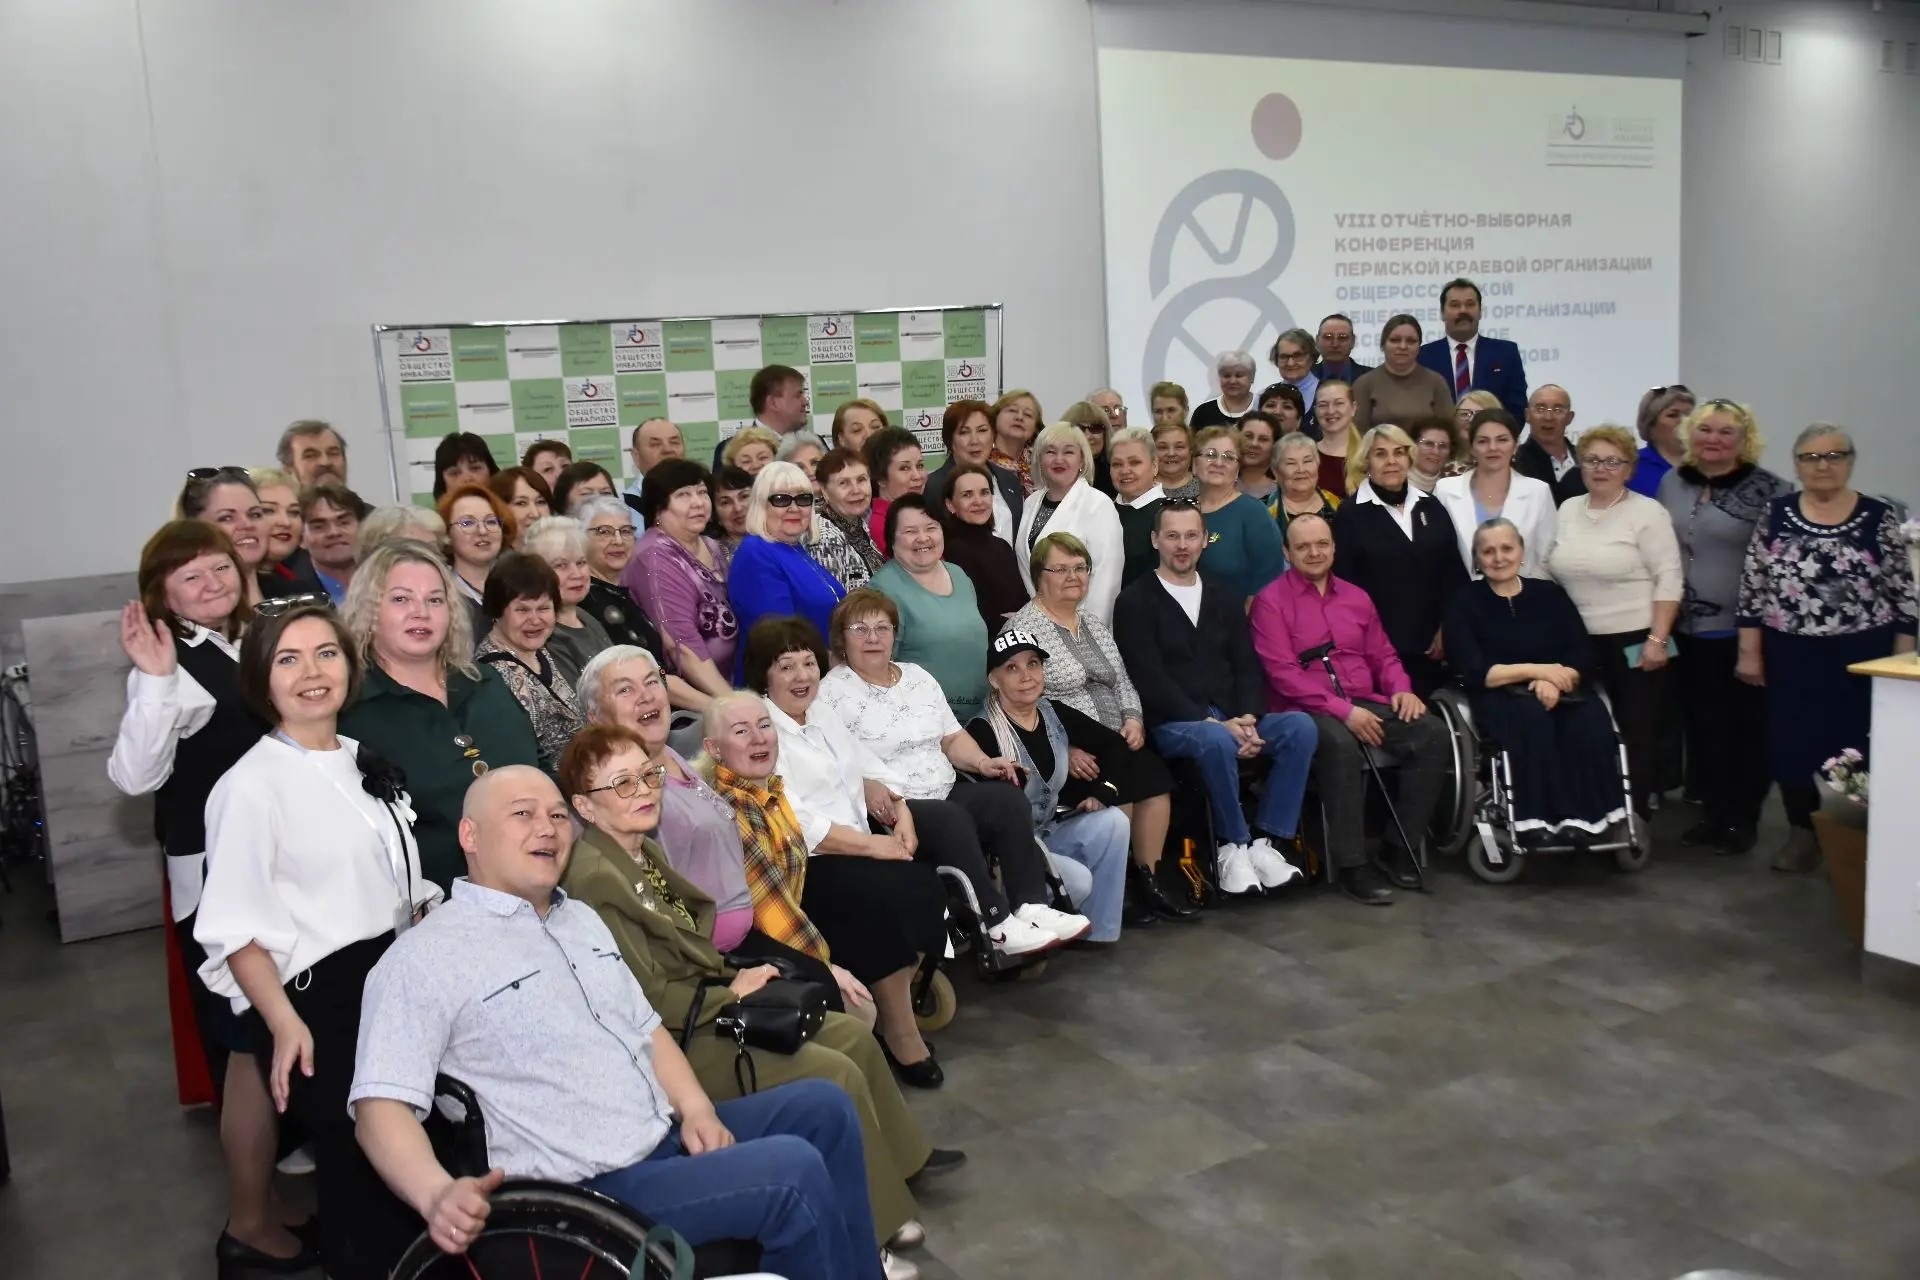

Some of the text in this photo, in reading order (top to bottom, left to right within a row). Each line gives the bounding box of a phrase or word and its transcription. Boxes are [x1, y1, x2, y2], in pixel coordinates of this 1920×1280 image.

[1334, 210, 1572, 228] VIII ОТЧЁТНО-ВЫБОРНАЯ
[1334, 236, 1474, 253] КОНФЕРЕНЦИЯ
[1335, 256, 1653, 277] ПЕРМСКОЙ КРАЕВОЙ ОРГАНИЗАЦИИ
[1336, 281, 1514, 303] ОБЩЕРОССКОЙ
[1492, 301, 1617, 319] ОРГАНИЗАЦИИ
[615, 353, 662, 361] ОБЩЕСТВО
[811, 345, 854, 353] ОБЩЕСТВО
[811, 352, 854, 360] ИНВАЛИДОВ
[568, 407, 617, 416] ОБЩЕСТВО
